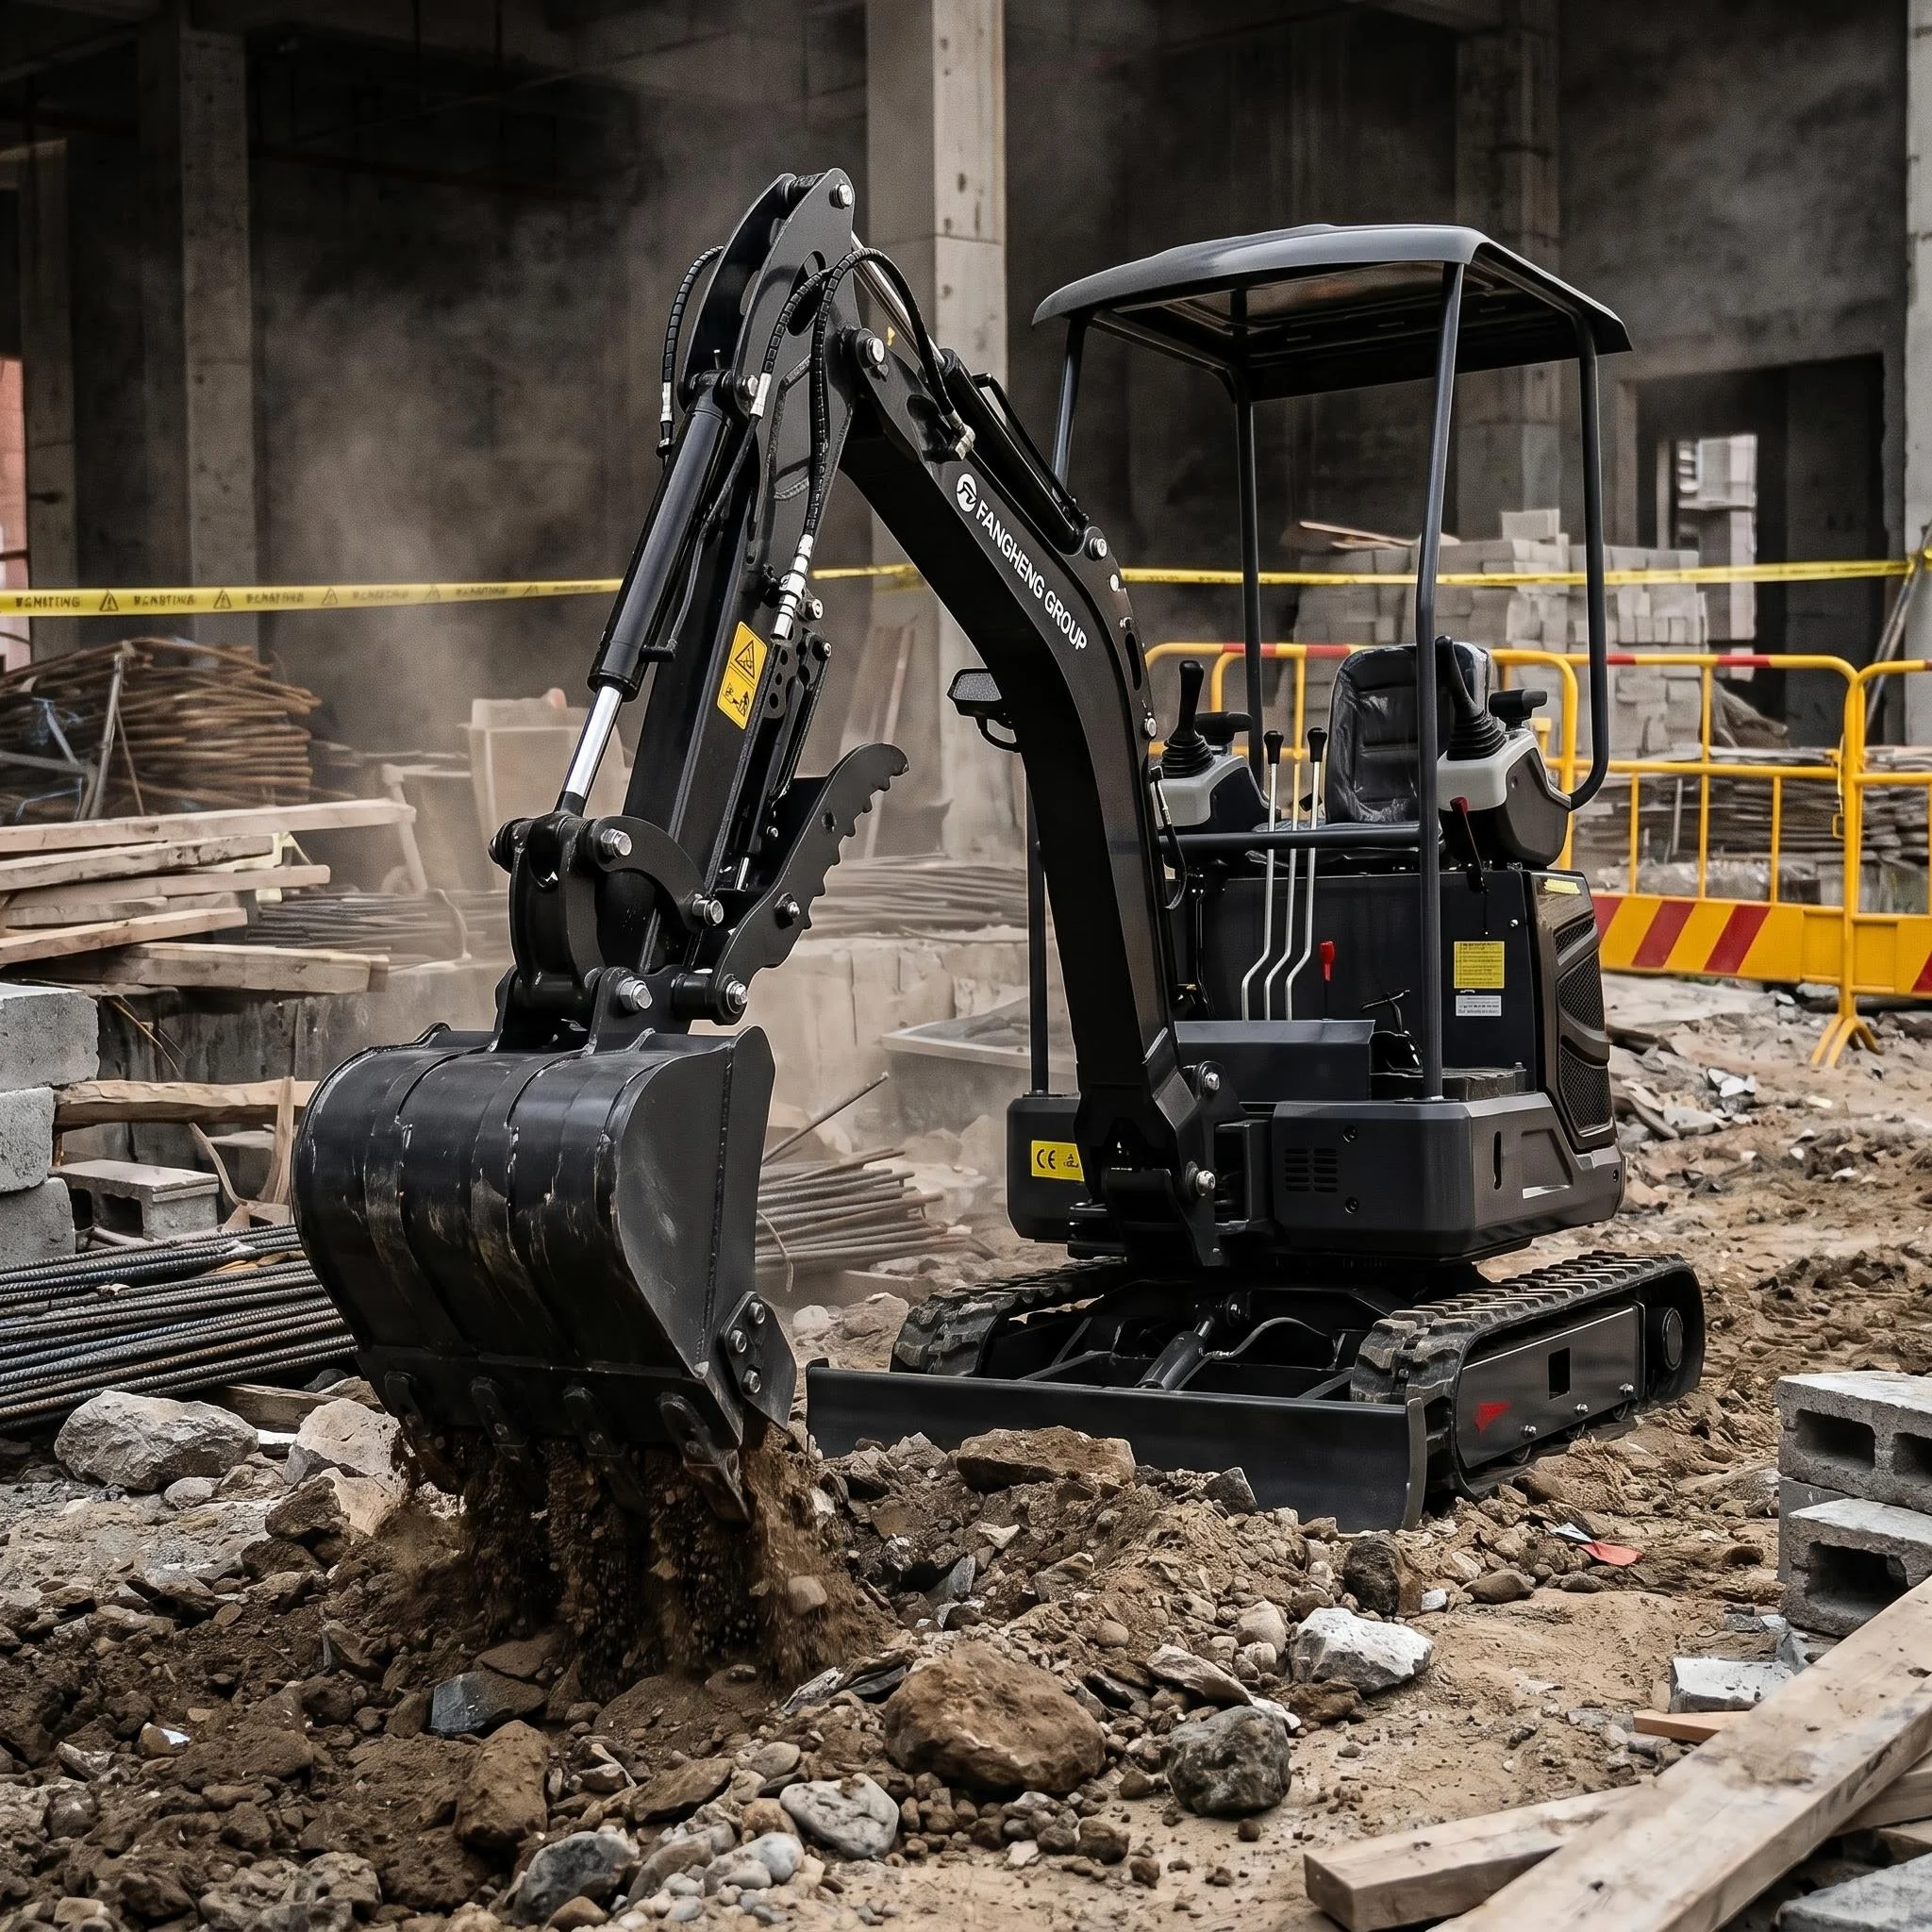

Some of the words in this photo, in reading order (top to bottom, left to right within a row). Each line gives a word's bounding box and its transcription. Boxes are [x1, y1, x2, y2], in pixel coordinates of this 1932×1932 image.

[975, 499, 1045, 599] FANGHENG
[1044, 590, 1088, 650] GROUP
[1036, 1148, 1057, 1170] CE
